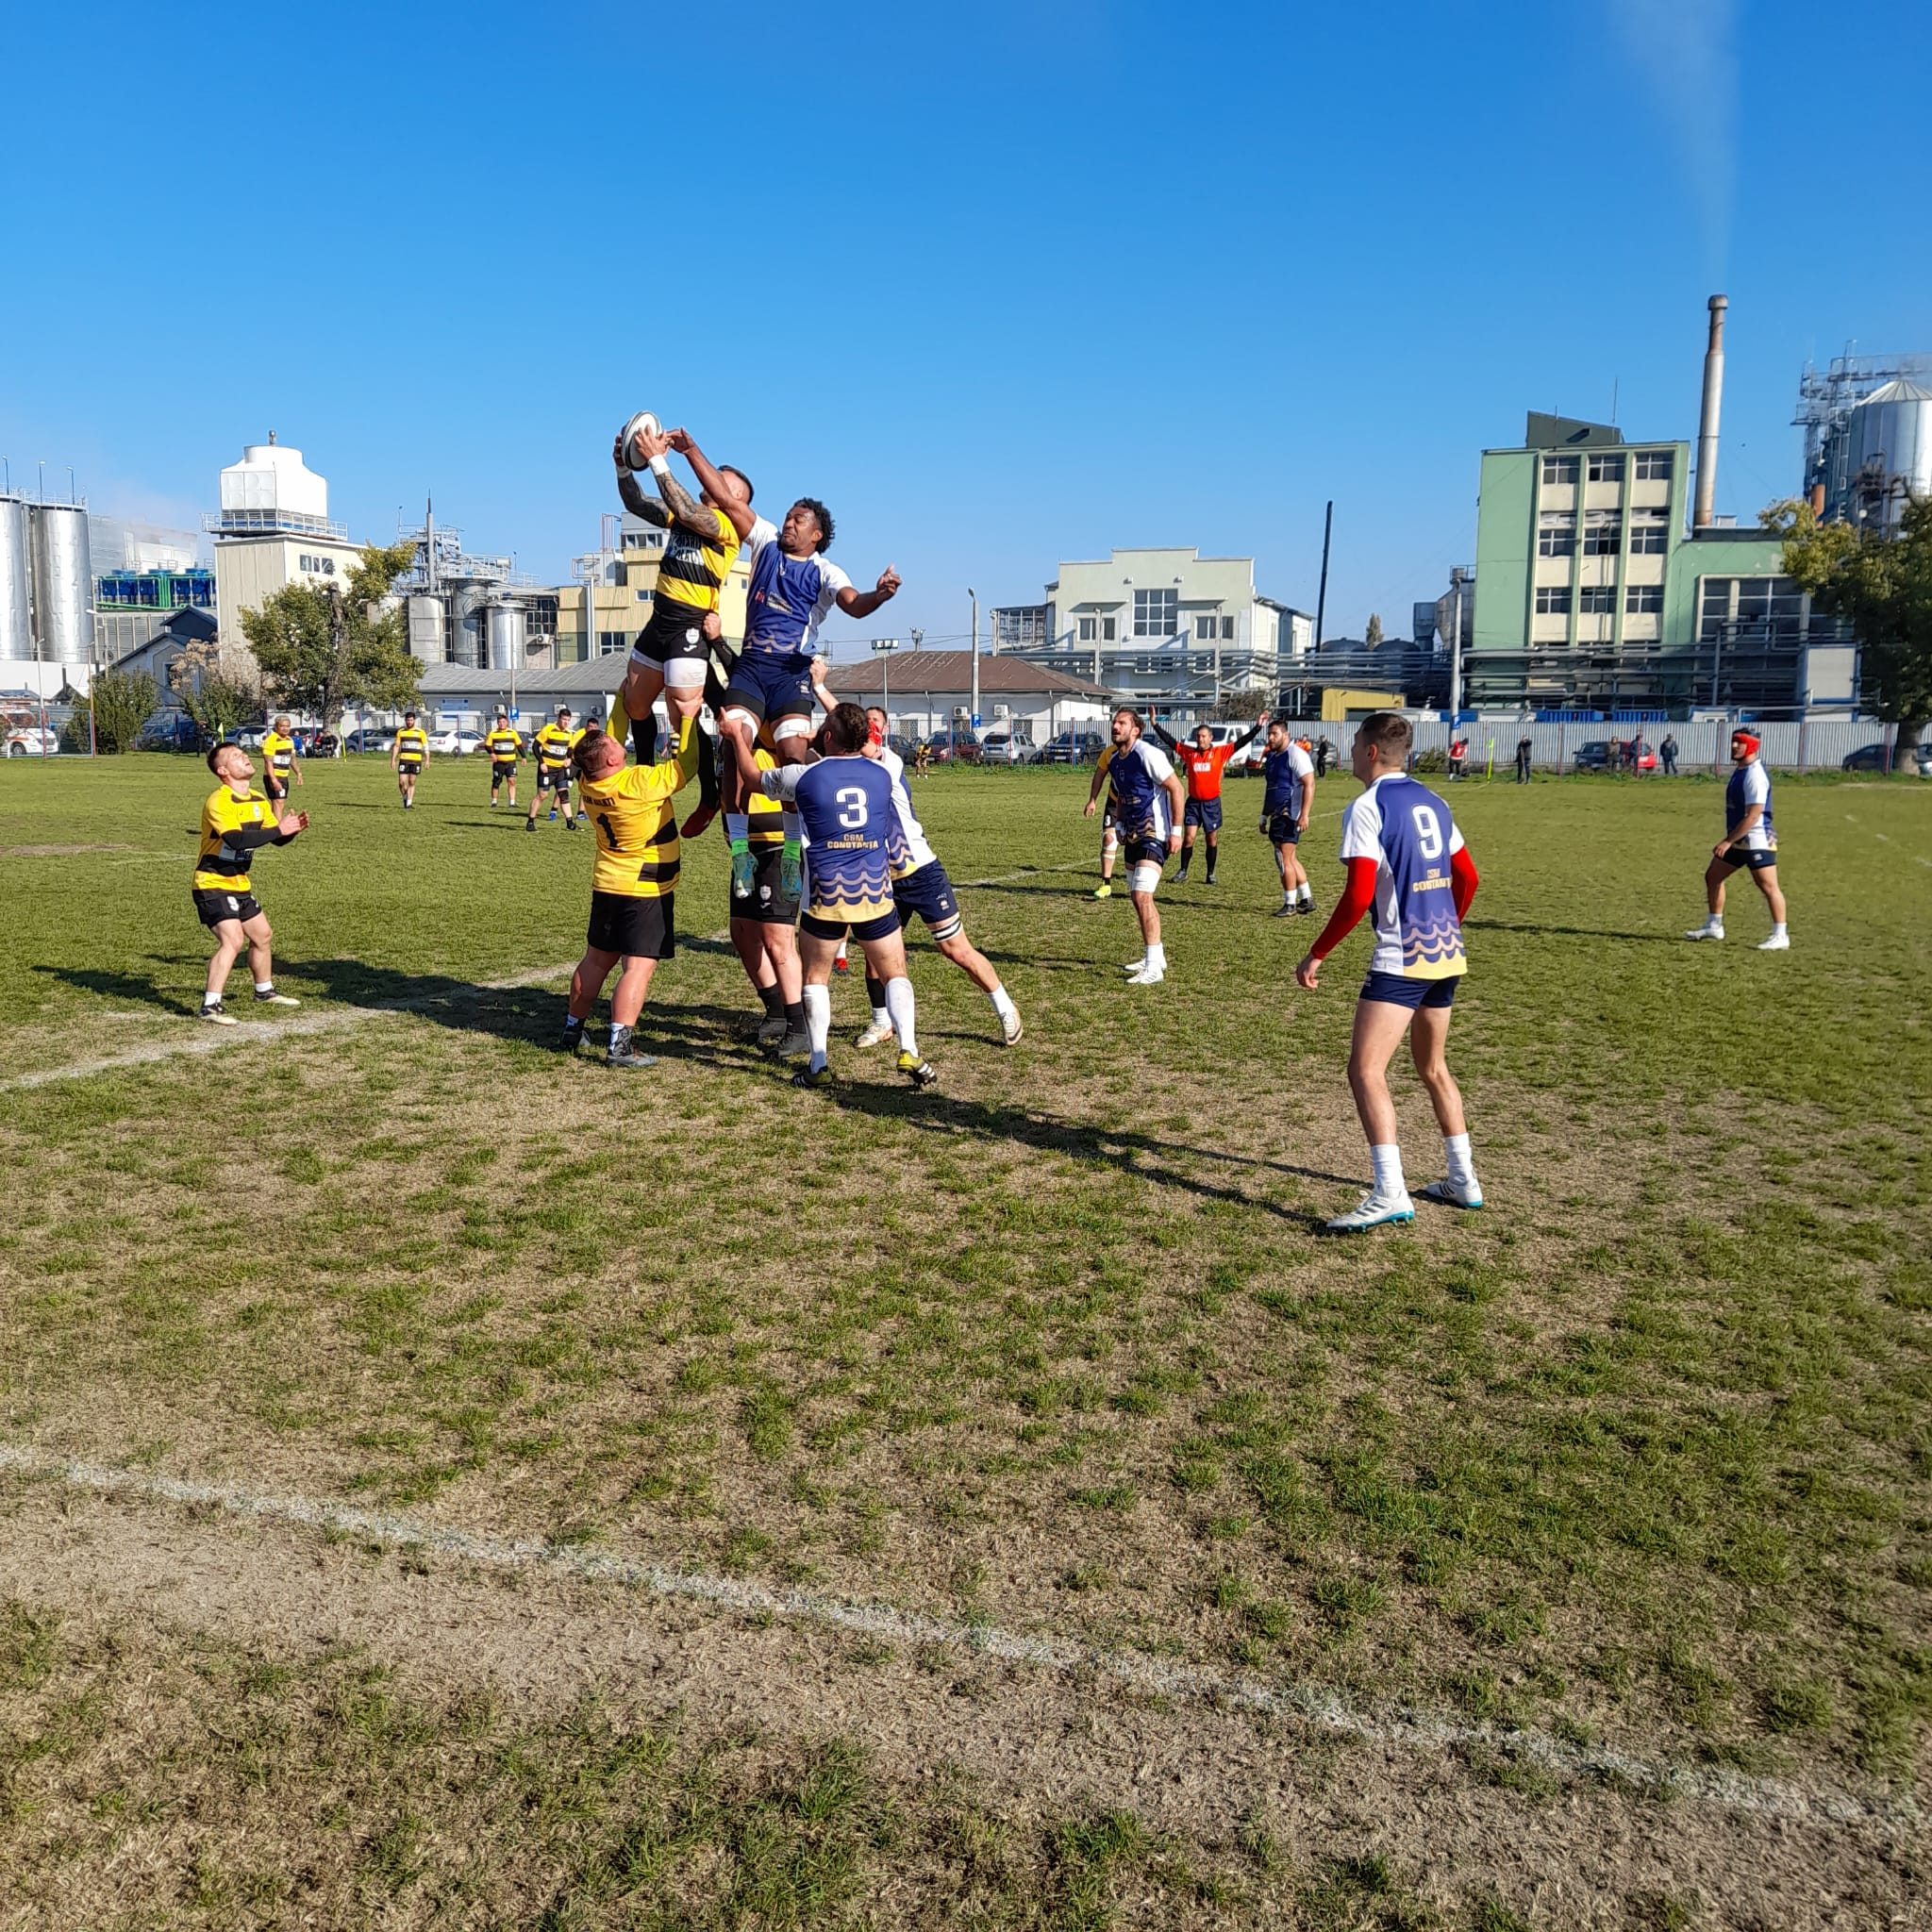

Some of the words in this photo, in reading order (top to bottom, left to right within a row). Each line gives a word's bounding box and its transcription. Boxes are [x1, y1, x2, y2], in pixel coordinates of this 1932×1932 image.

[835, 786, 868, 829] 3
[596, 812, 625, 853] 1
[842, 833, 864, 841] CSM
[1411, 804, 1443, 860] 9
